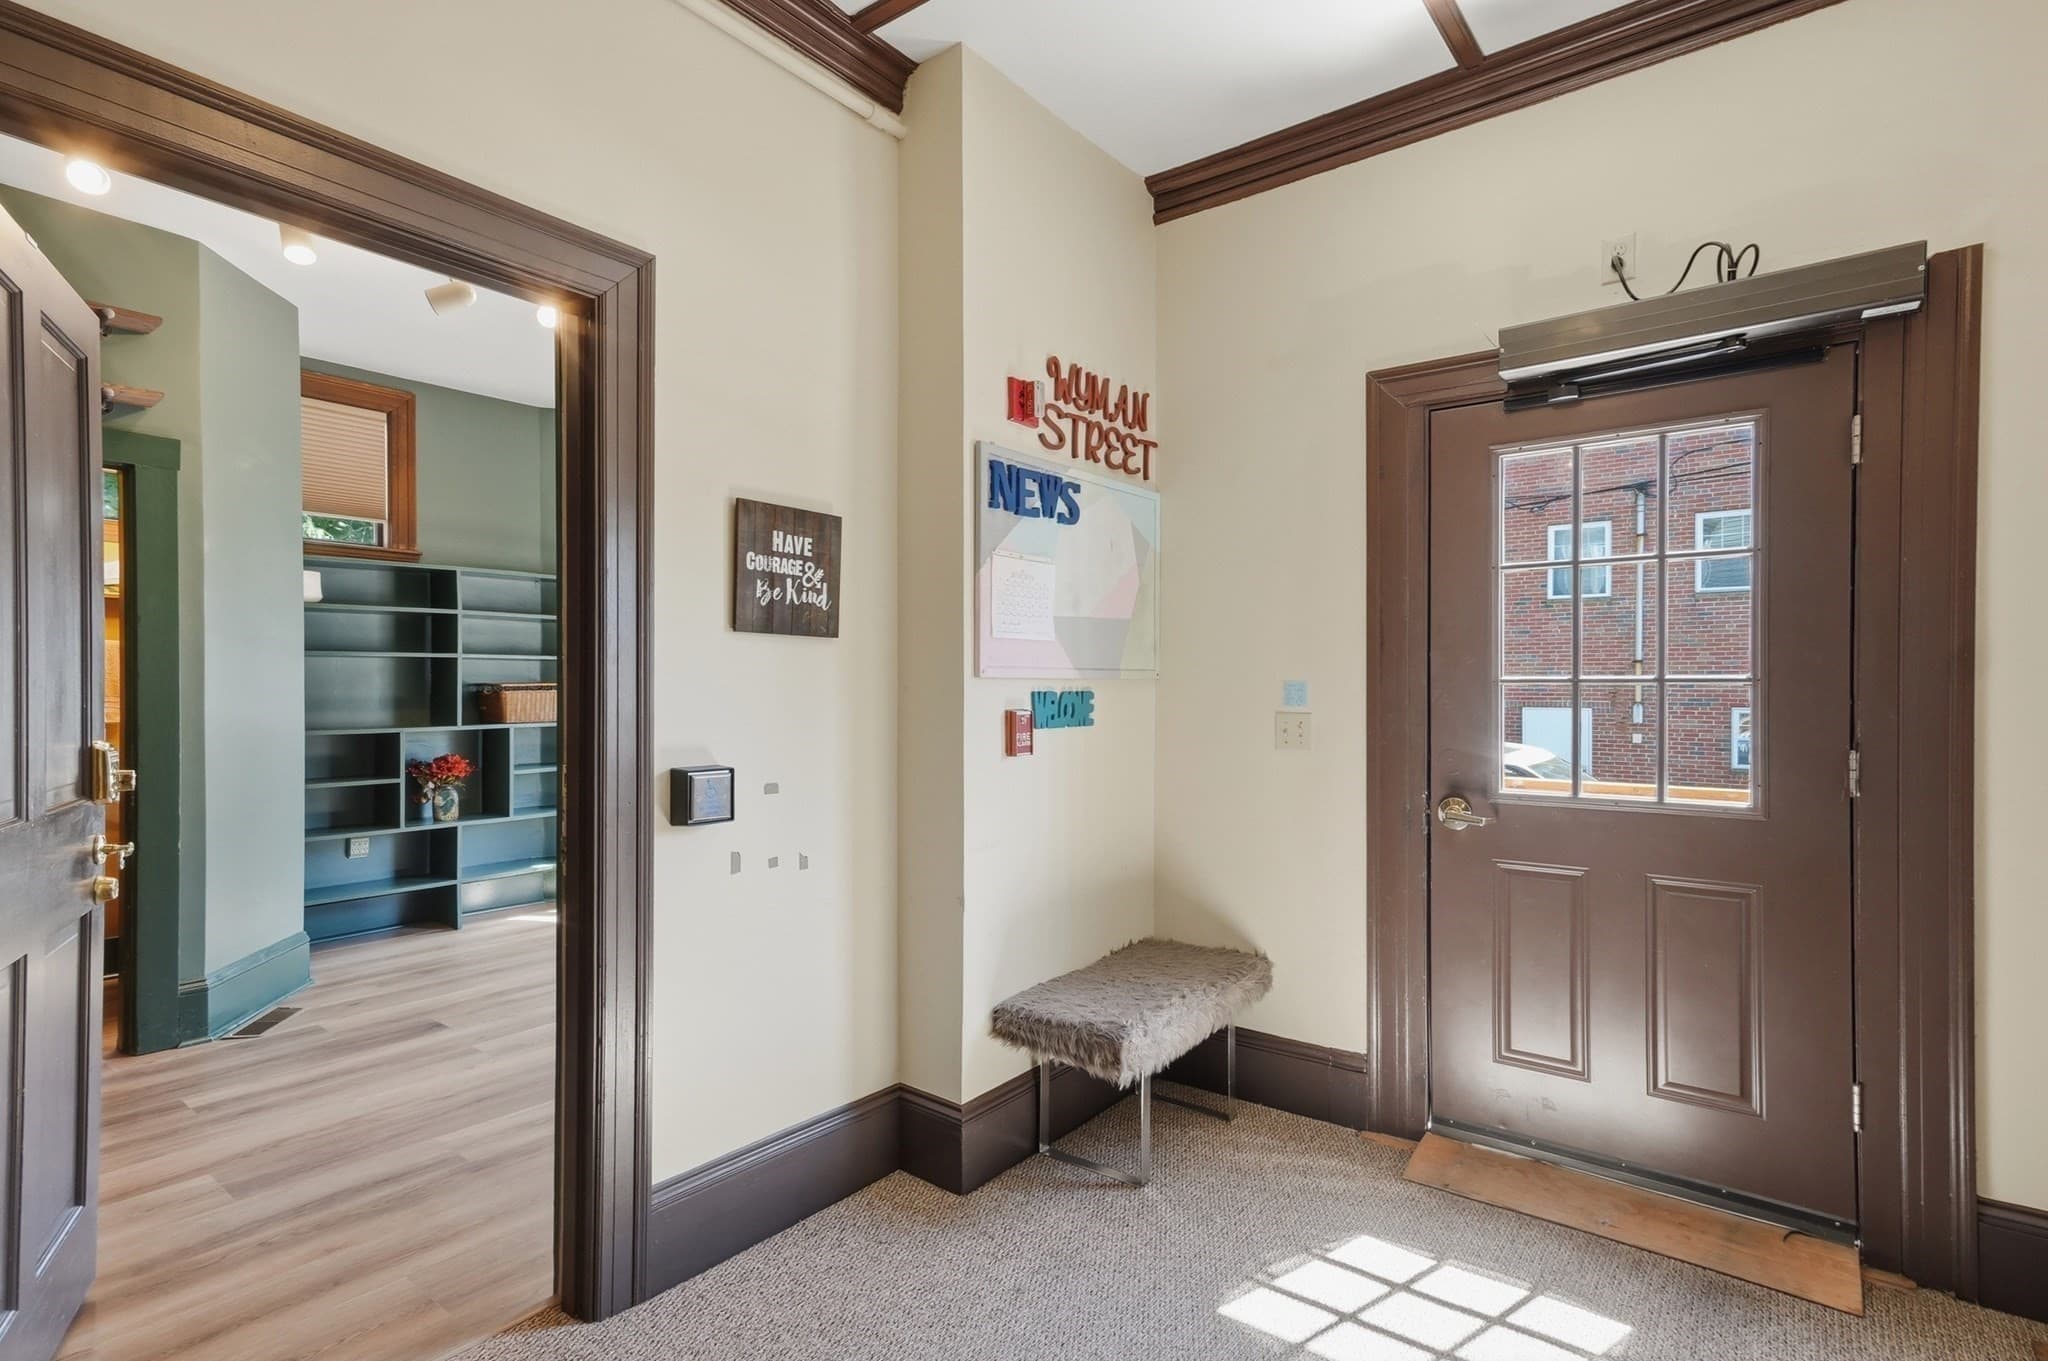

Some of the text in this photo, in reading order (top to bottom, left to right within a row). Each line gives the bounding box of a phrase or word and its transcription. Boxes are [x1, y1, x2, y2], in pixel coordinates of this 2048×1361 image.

[1046, 356, 1150, 432] WYMAN
[1038, 403, 1159, 480] STREET
[988, 459, 1081, 526] NEWS
[772, 530, 813, 557] HAVE
[756, 577, 832, 611] Be Kind
